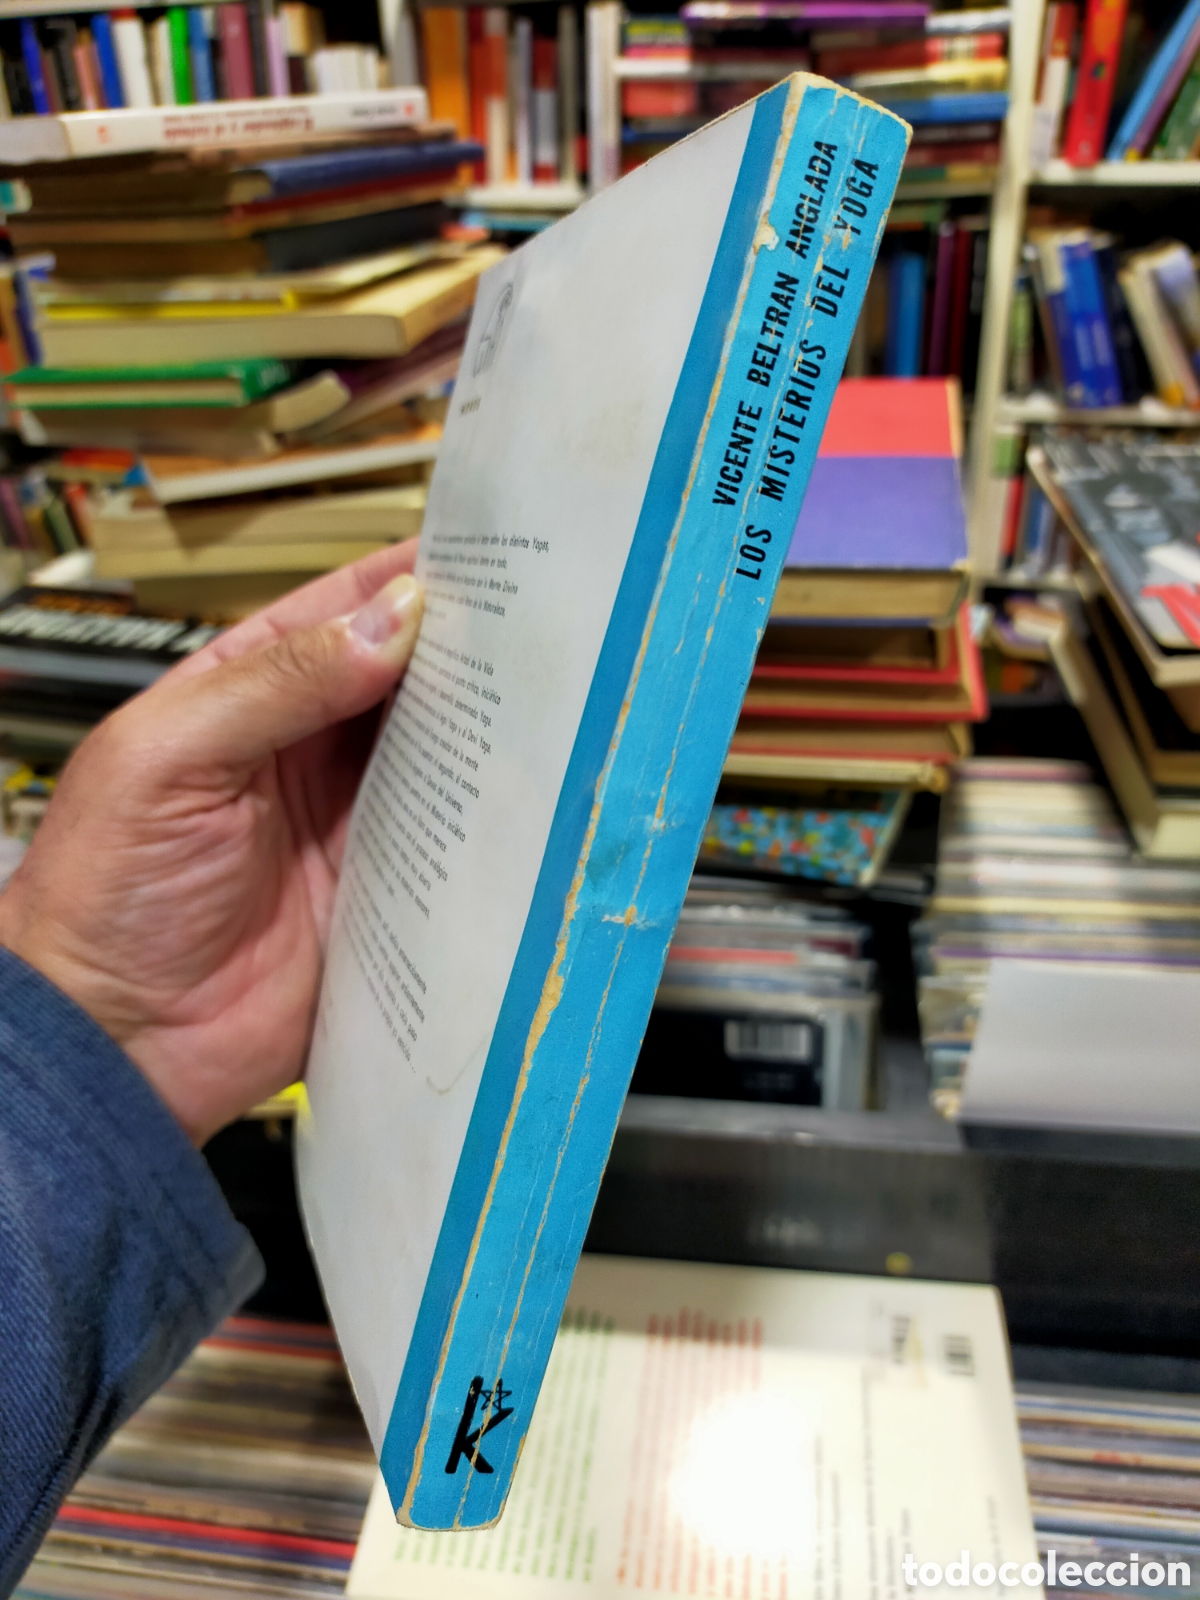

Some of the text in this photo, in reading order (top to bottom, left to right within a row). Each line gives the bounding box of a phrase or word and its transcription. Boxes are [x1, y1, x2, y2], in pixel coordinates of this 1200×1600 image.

[712, 140, 838, 506] VICENTE BELTRAN ANGLADA
[735, 158, 879, 580] LOS MISTERIOS DEL YOGA
[483, 660, 494, 676] Vida
[465, 755, 478, 772] mente
[461, 779, 480, 799] contacto
